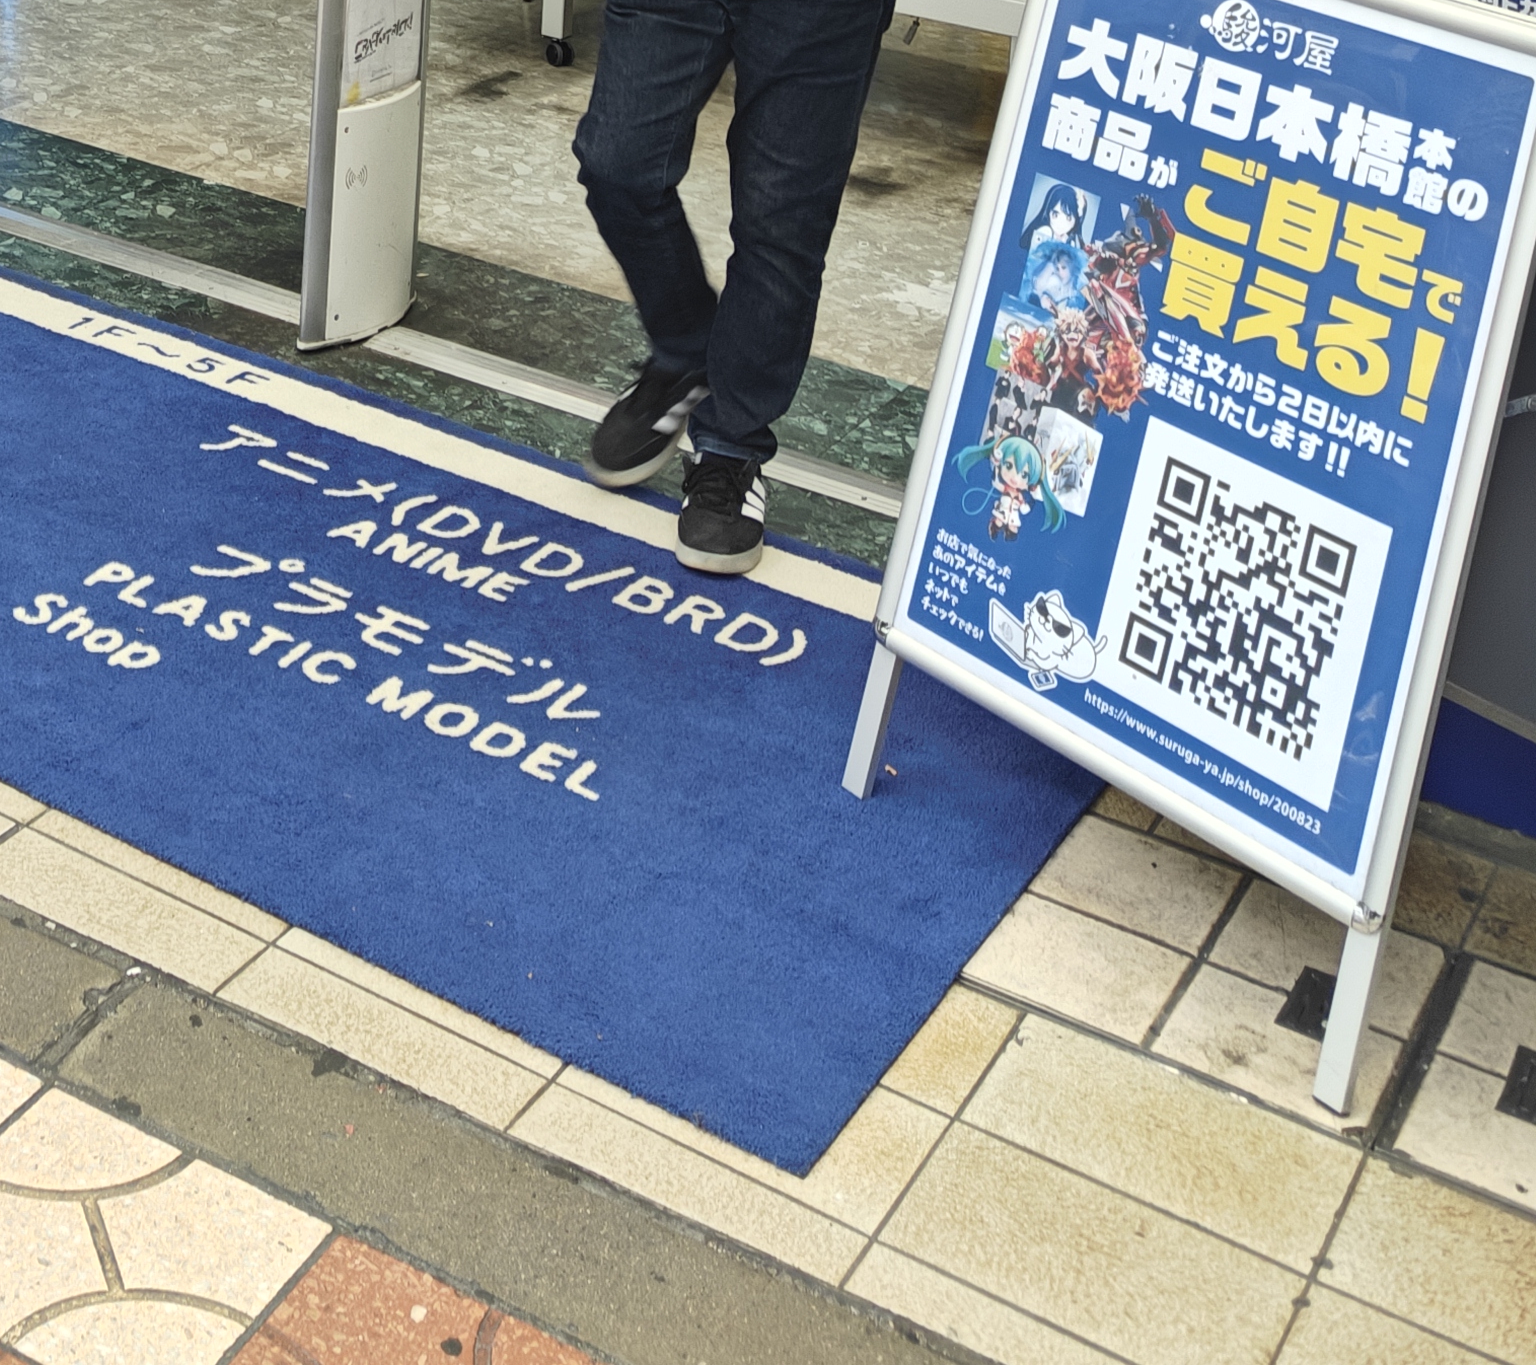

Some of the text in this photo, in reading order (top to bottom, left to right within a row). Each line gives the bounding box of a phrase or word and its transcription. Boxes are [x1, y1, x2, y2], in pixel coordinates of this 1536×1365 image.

[1182, 146, 1464, 325] ご自宅で
[1151, 328, 1415, 469] ご注文から2日以内に
[13, 592, 162, 671] Shop
[327, 519, 531, 605] ANIME
[924, 578, 959, 607] ネットで
[928, 561, 969, 595] いつでも
[83, 560, 601, 802] PLASTIC MODEL
[189, 544, 601, 724] プラモデル
[1082, 688, 1323, 836] https://www.suruga-ya.jp/shop/200823
